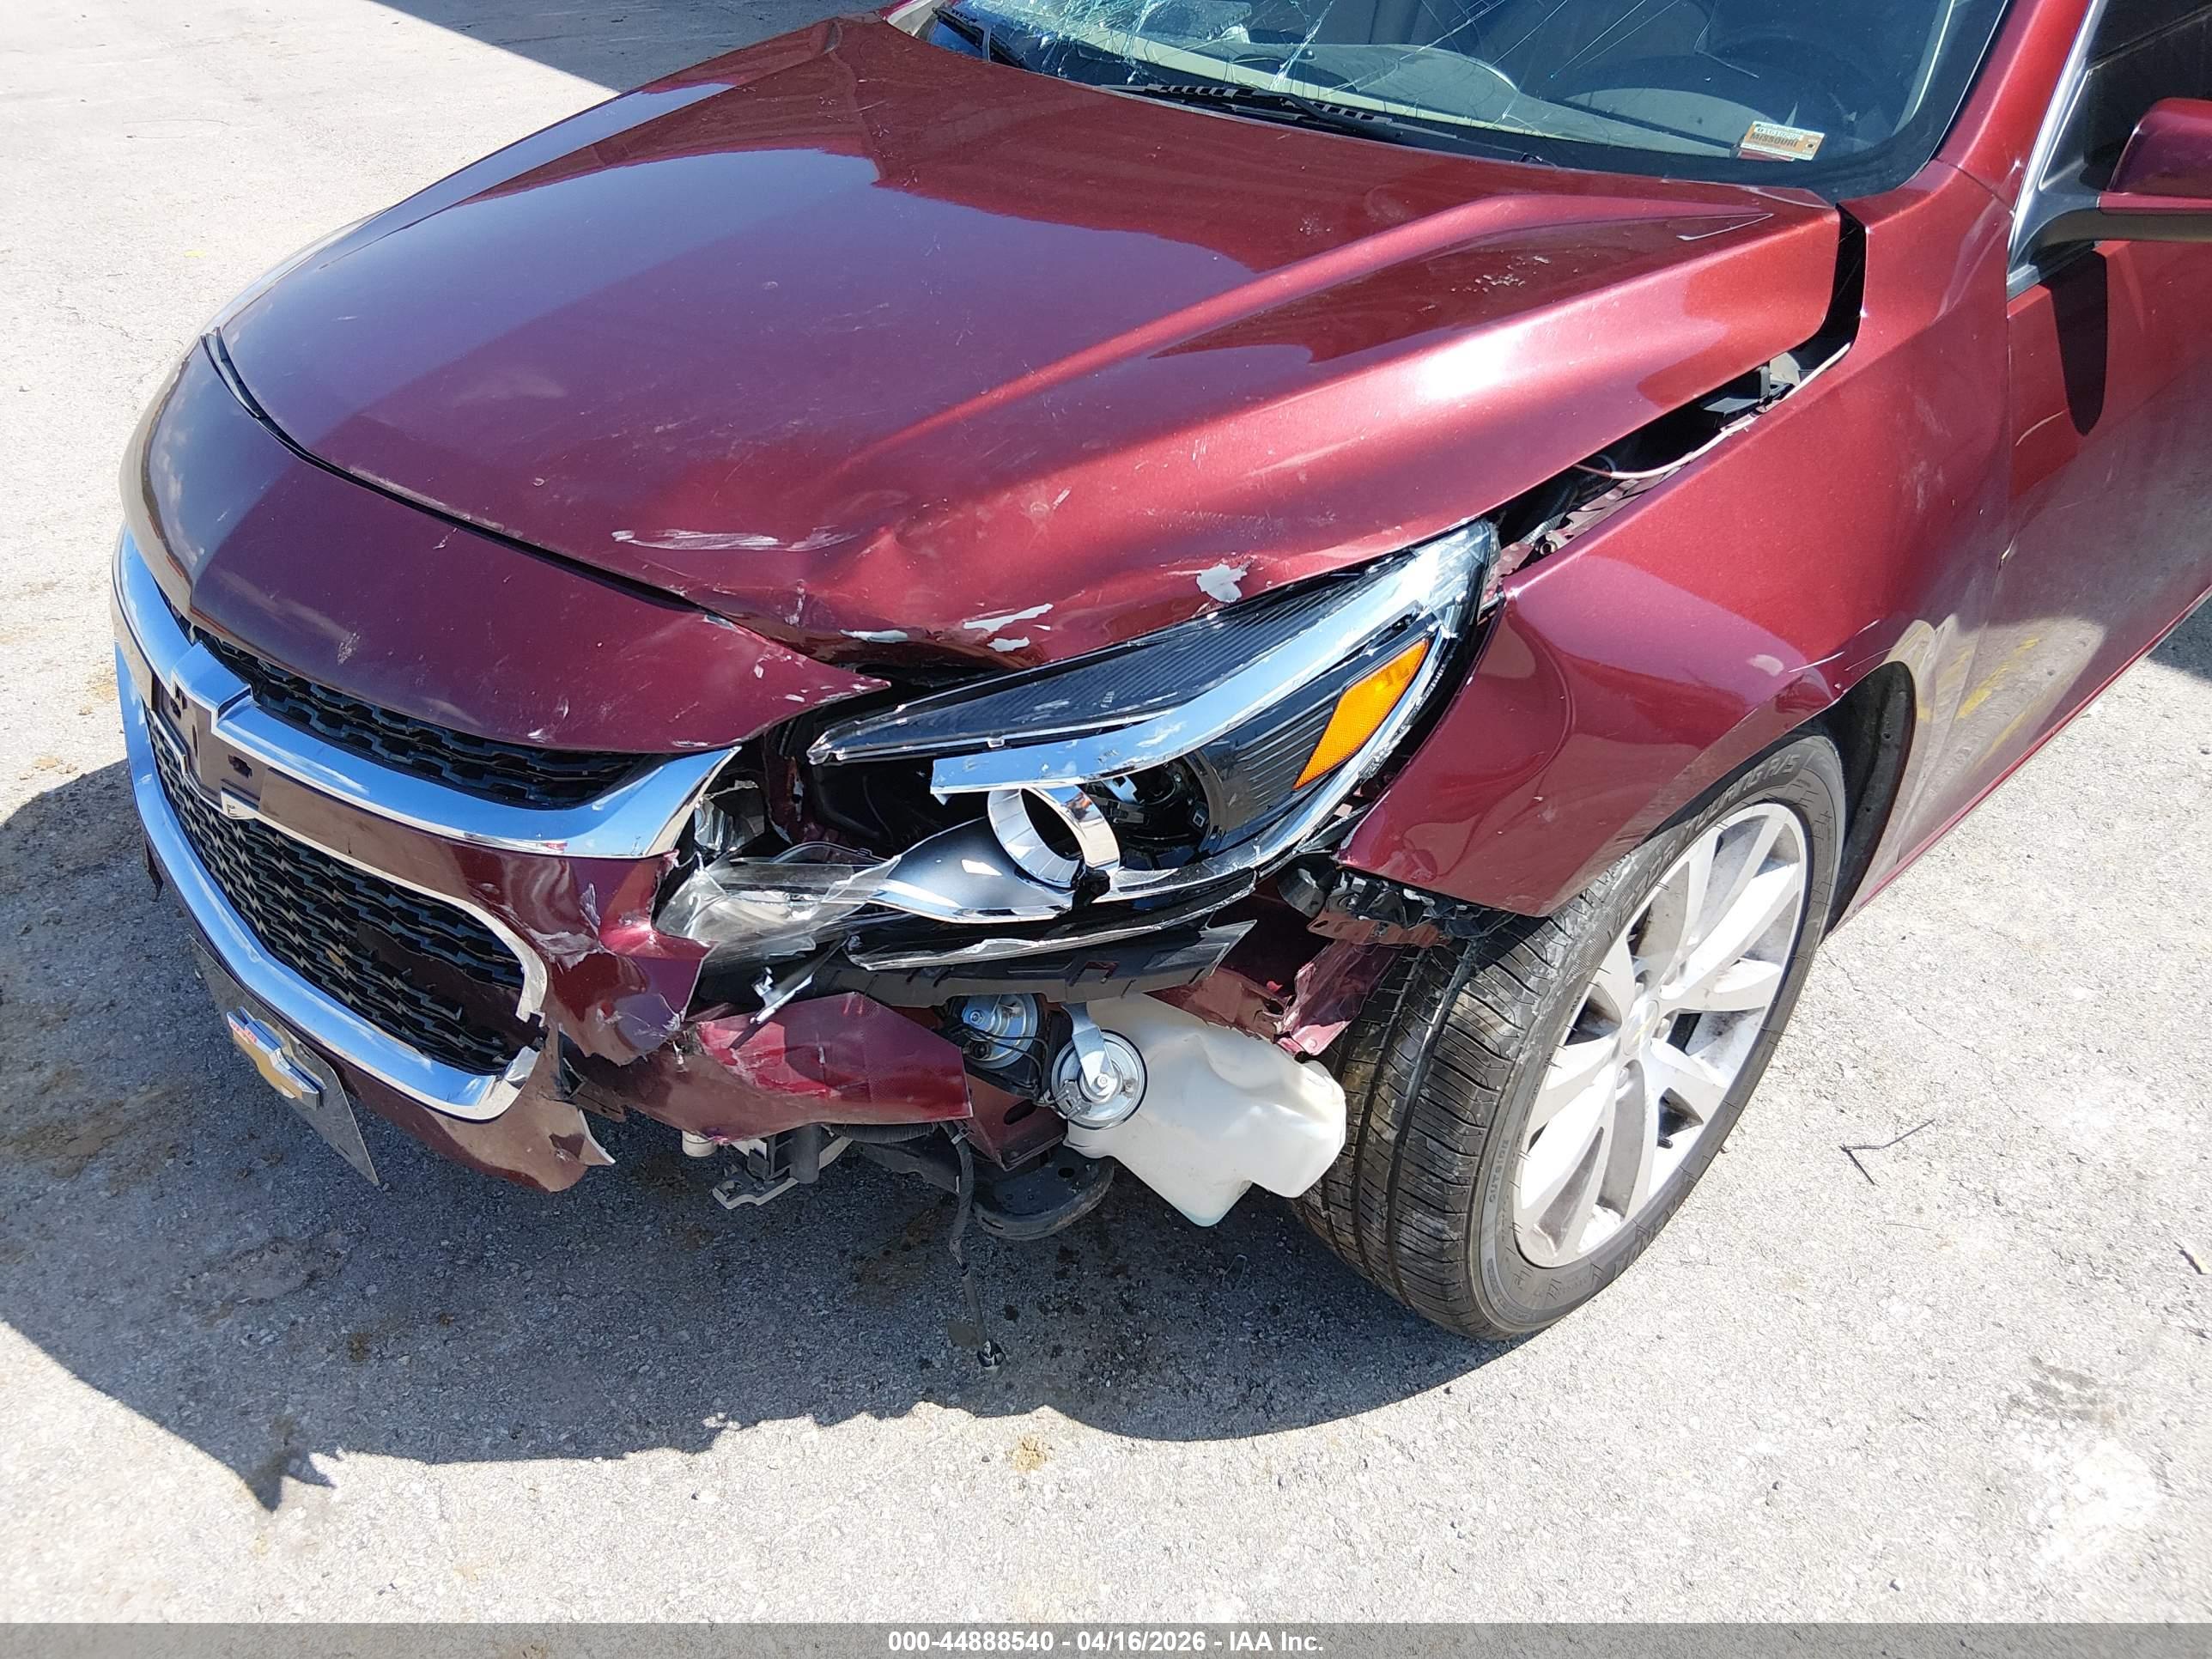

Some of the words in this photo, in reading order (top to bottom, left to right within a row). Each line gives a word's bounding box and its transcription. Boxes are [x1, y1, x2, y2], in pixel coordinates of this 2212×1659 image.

[1751, 132, 1798, 147] MISSOURI
[1685, 763, 1765, 842] TOURING
[1765, 754, 1801, 777] A/S
